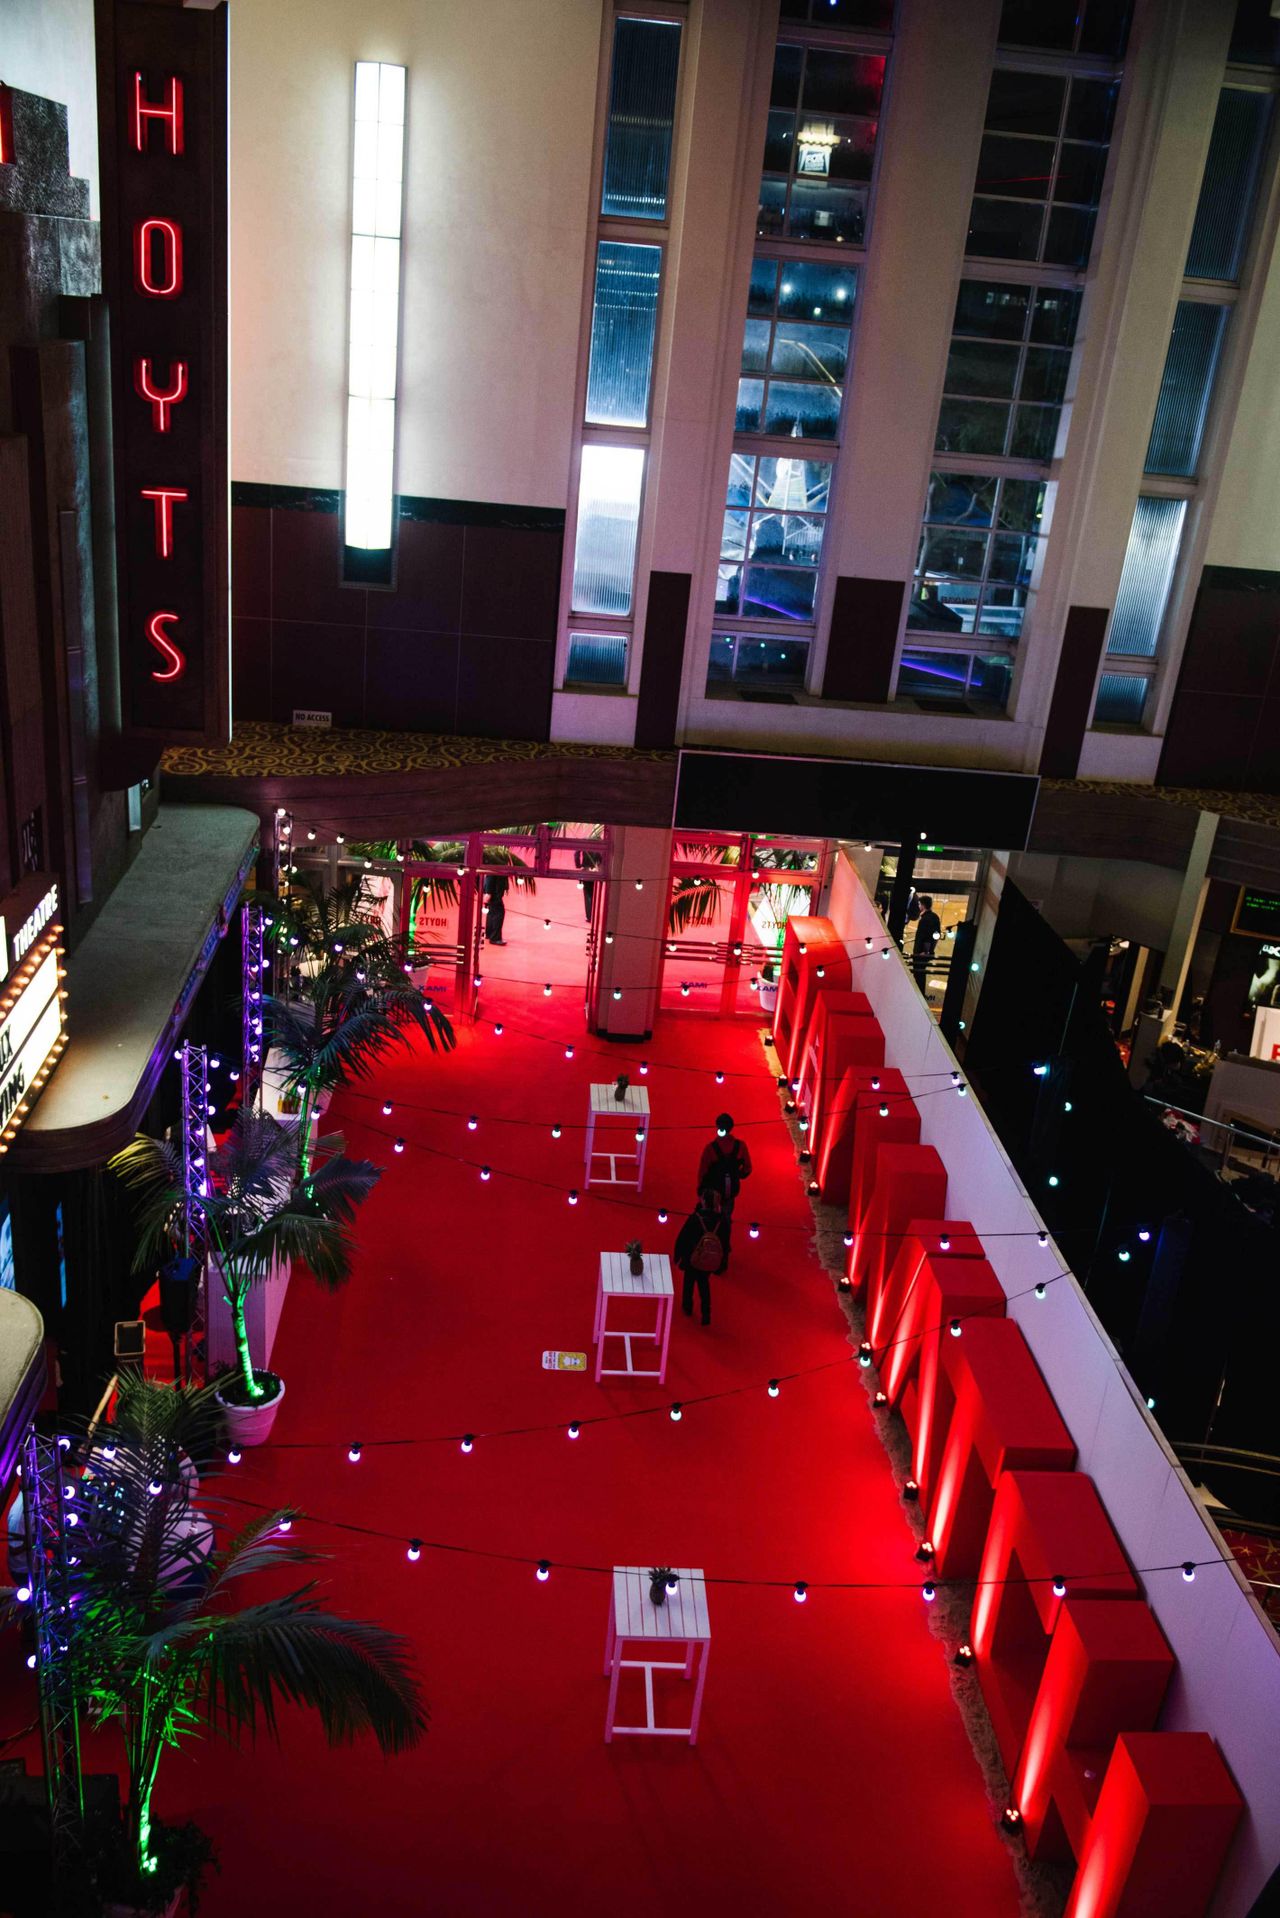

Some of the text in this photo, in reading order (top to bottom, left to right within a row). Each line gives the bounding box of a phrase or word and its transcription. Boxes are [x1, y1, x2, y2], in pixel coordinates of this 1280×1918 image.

[128, 70, 188, 684] HOYTS
[295, 711, 330, 722] NO ACCESS
[13, 883, 58, 962] THEATRE
